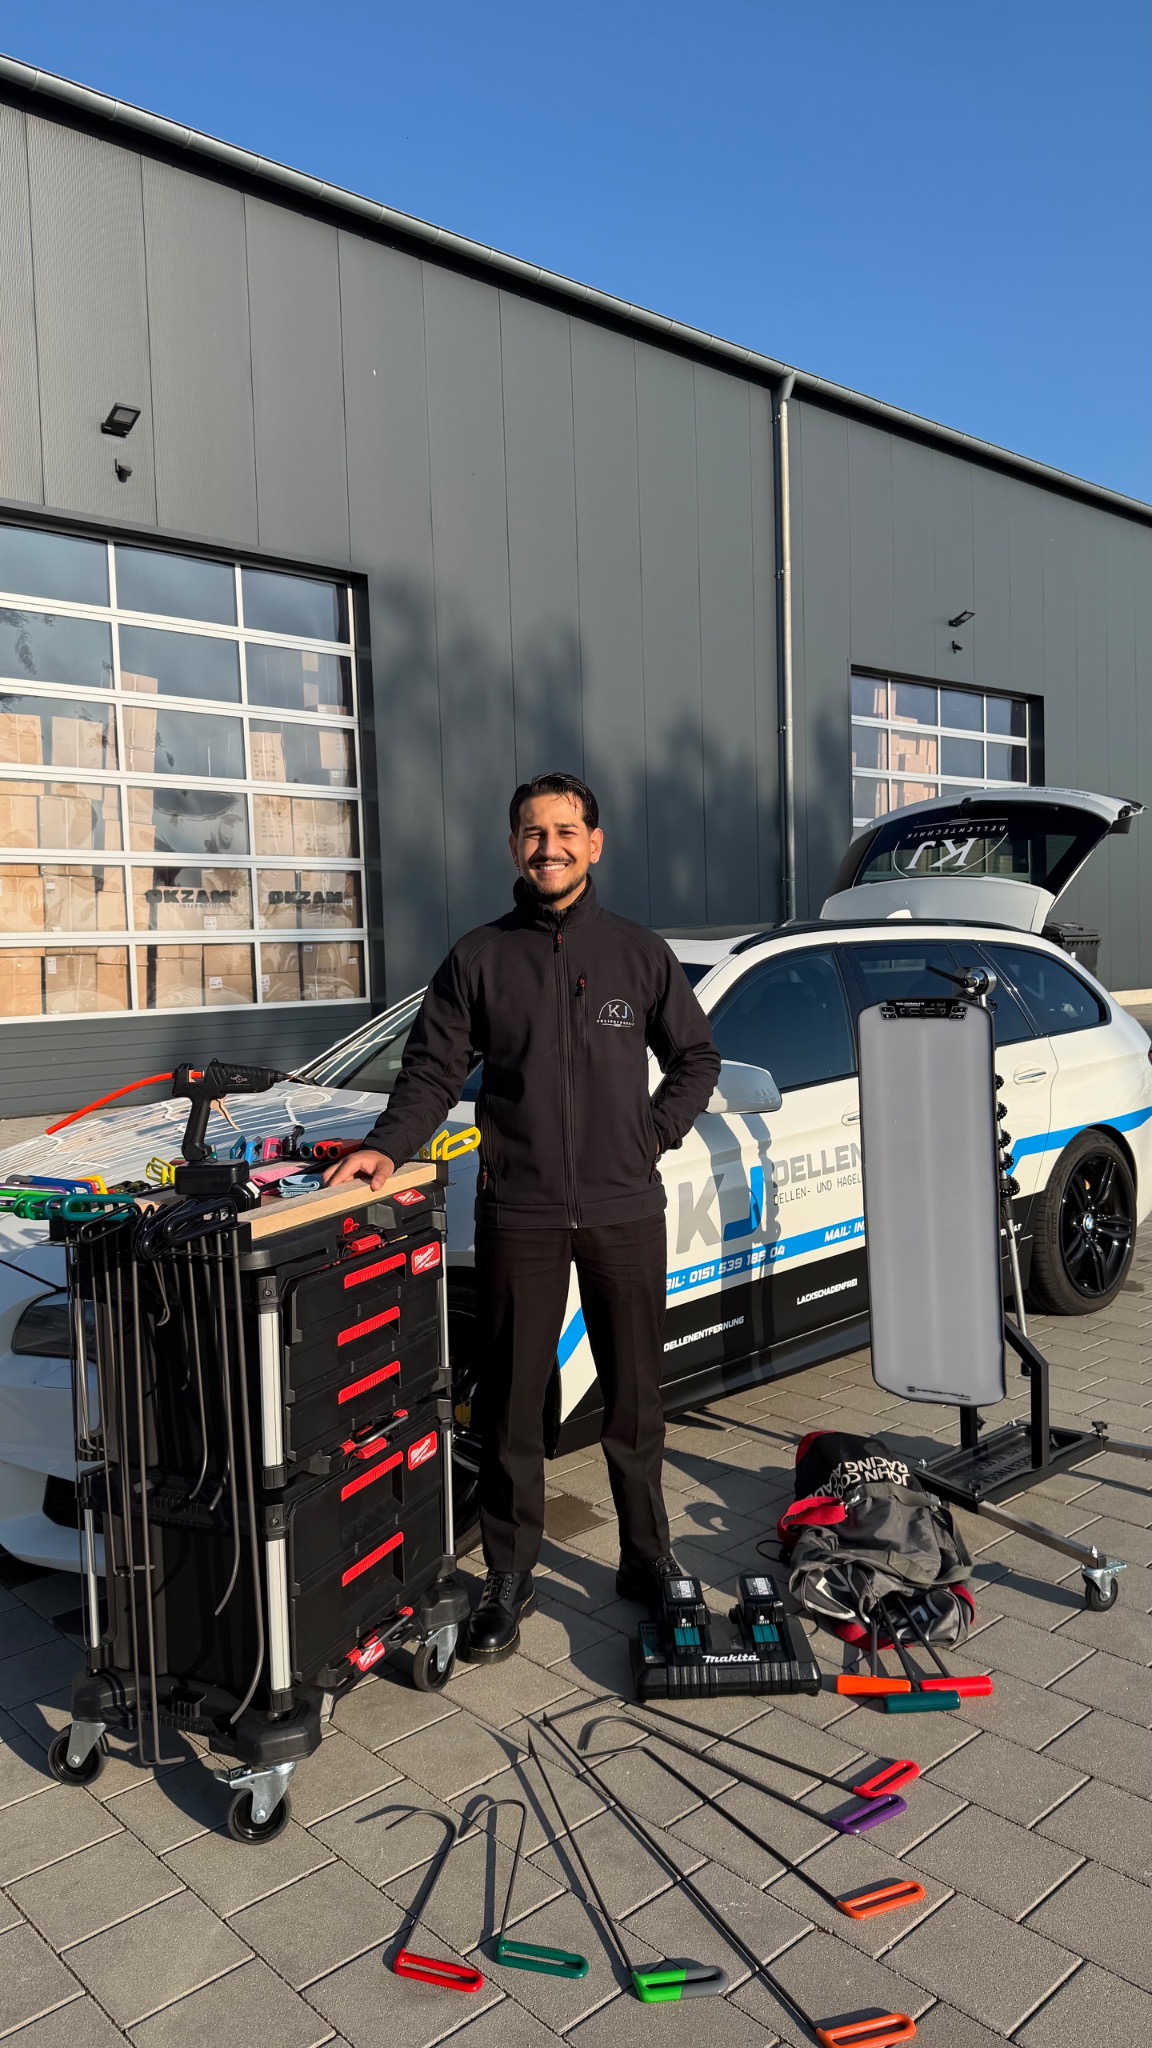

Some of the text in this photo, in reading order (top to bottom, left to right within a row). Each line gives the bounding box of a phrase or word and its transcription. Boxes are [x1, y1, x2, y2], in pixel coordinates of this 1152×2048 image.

[906, 825, 1006, 839] DELLENTECHNIK
[904, 837, 980, 870] KJ
[608, 1004, 628, 1019] KJ
[773, 1142, 861, 1189] DELLEN
[774, 1173, 862, 1206] DELLEN- UND HAGEL
[676, 1165, 764, 1254] KJ
[689, 1265, 715, 1283] 0151
[718, 1257, 743, 1275] 539
[769, 1245, 786, 1259] 04
[824, 1225, 852, 1243] MAIL:
[796, 1278, 858, 1306] LACKSCHADENFREI
[663, 1315, 745, 1352] DELLENENTFERNUNG
[844, 1456, 909, 1474] RACING
[864, 1467, 910, 1486] JOHN
